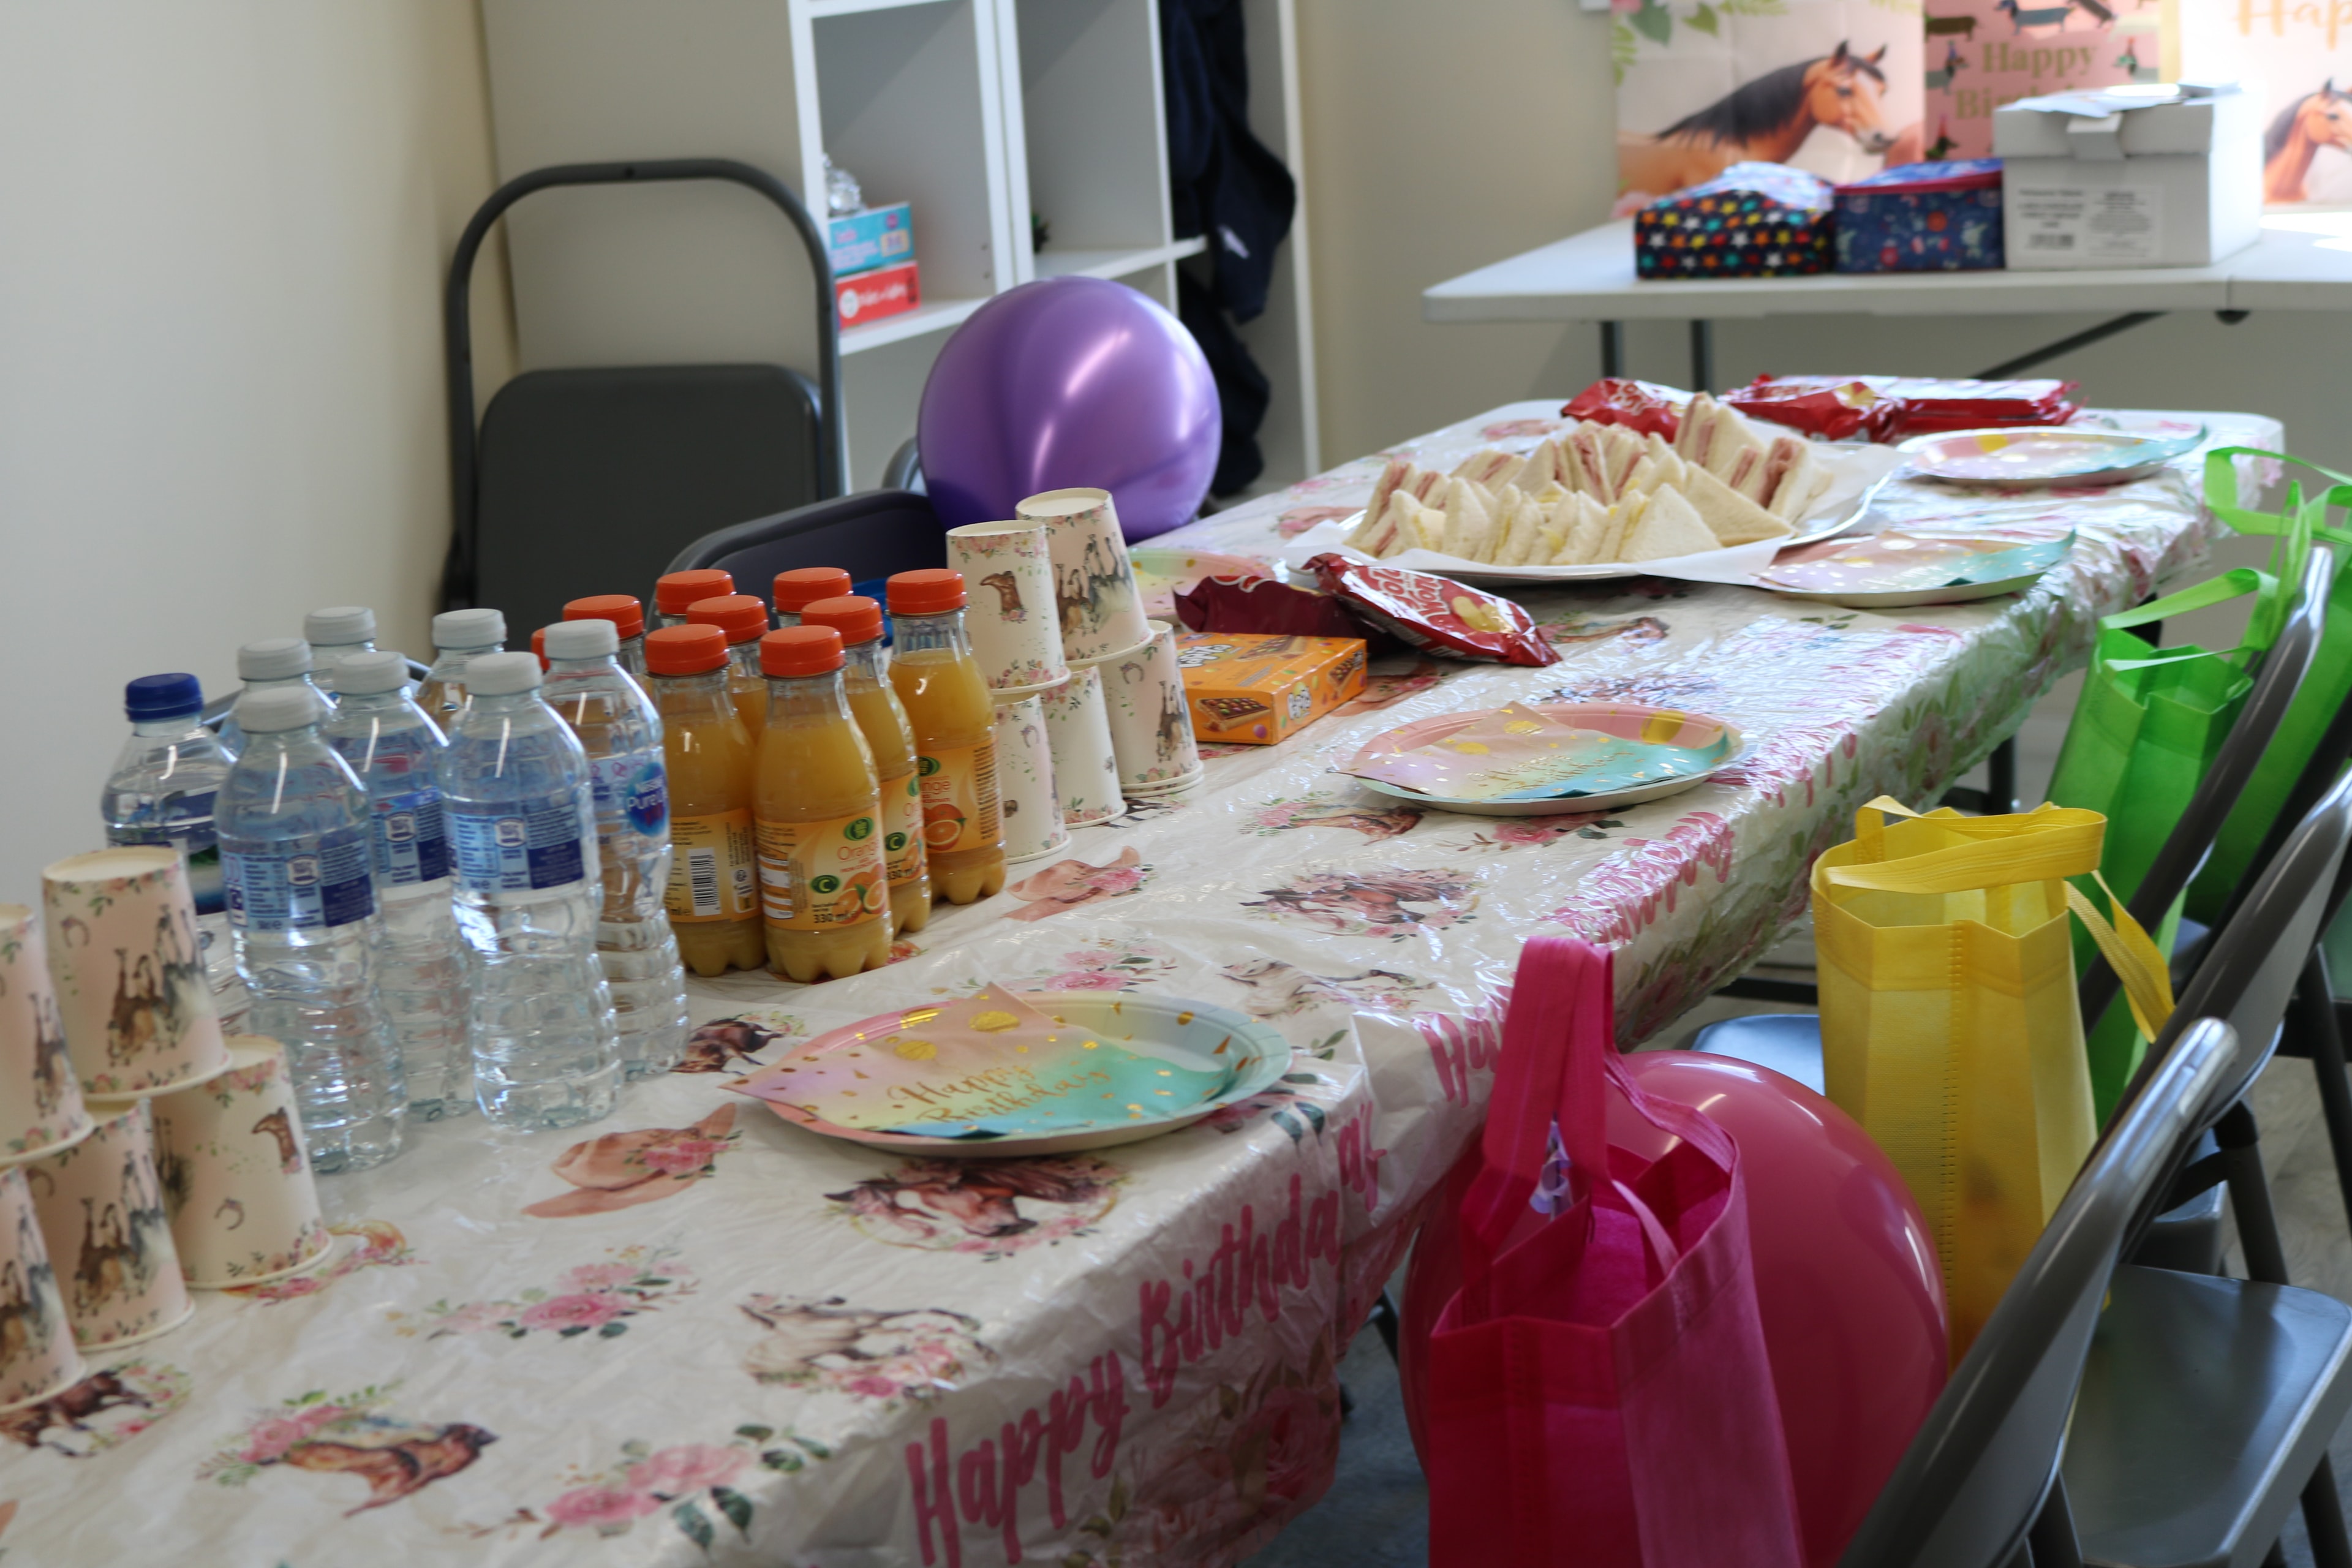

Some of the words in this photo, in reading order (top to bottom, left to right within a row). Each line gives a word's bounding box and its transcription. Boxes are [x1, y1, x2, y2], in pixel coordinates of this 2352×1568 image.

[1981, 41, 2098, 78] Happy
[886, 1065, 1036, 1104] Happy
[915, 1068, 1111, 1123] Birthday
[905, 1349, 1131, 1568] Happy
